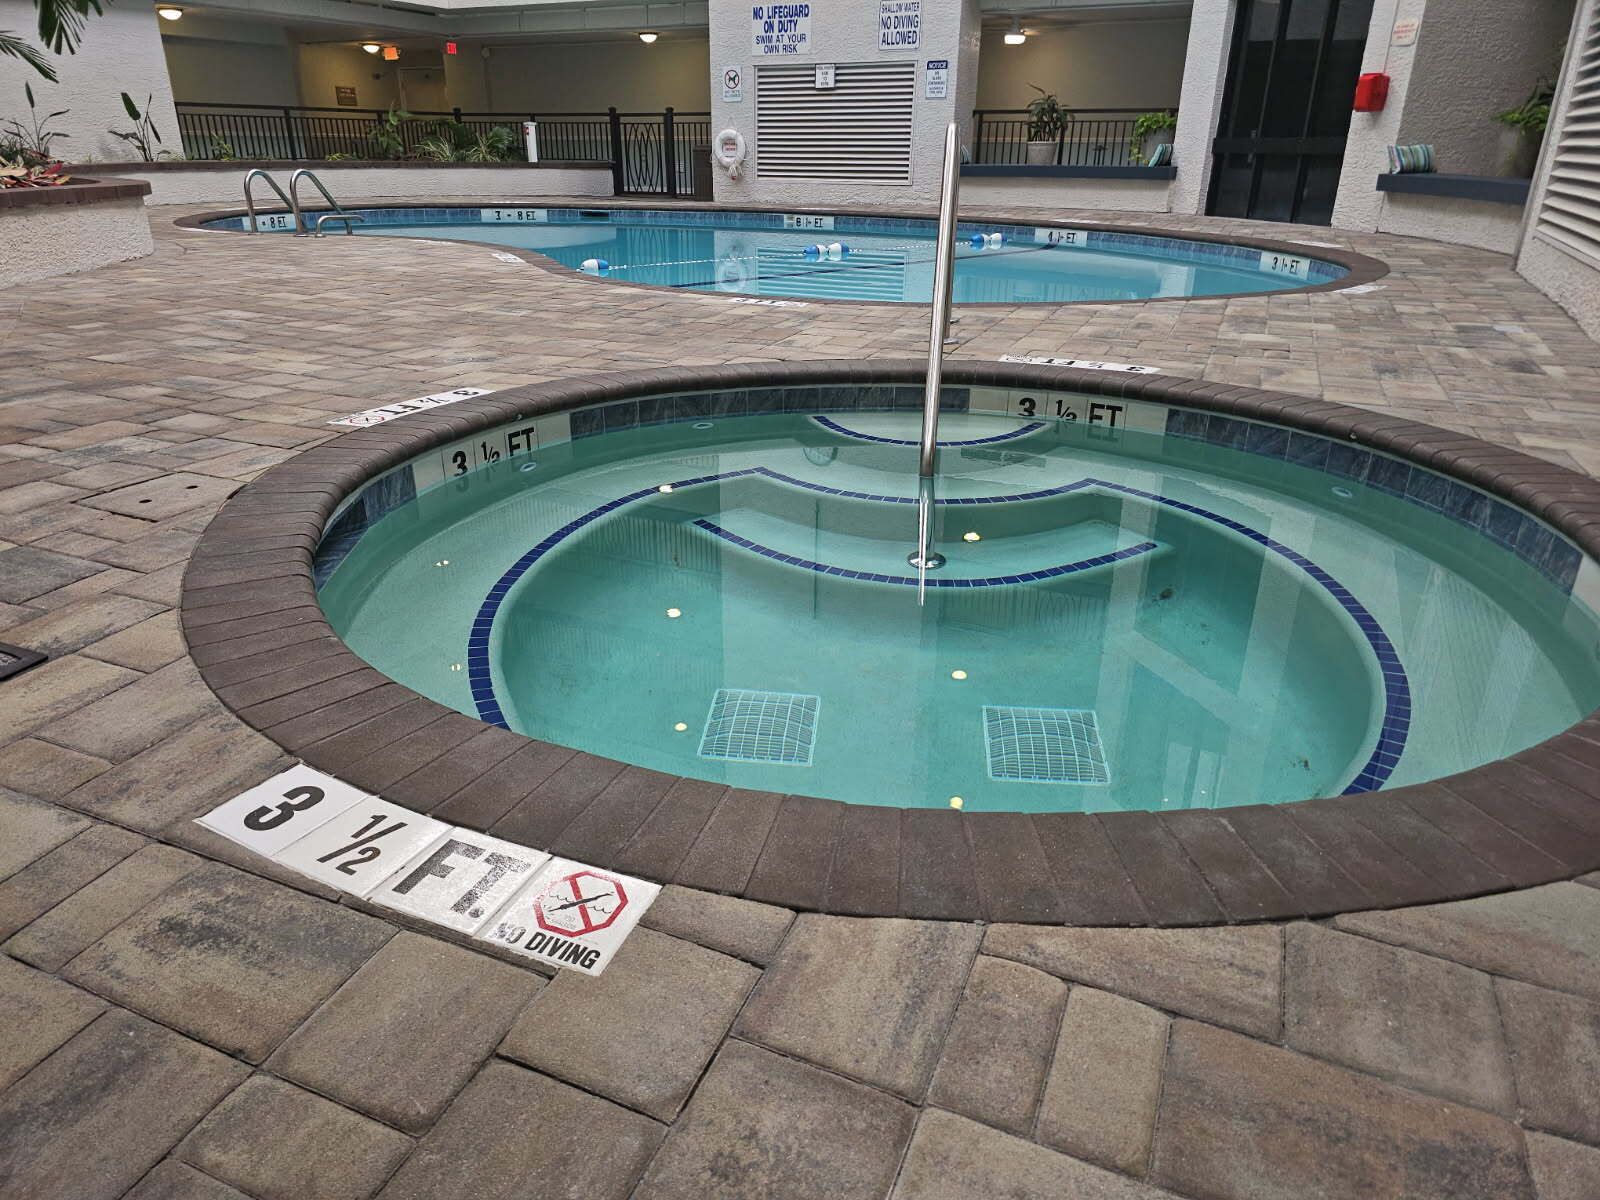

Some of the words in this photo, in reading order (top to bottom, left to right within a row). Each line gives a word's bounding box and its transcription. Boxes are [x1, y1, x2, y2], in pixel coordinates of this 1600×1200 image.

[753, 6, 763, 20] NO
[767, 4, 810, 19] LIFEGUARD
[903, 2, 919, 12] WATER
[764, 20, 774, 33] ON
[778, 19, 798, 33] DUTY
[881, 16, 891, 29] NO
[893, 15, 919, 29] DIVING
[756, 35, 773, 44] SWIM
[776, 34, 784, 43] AT
[787, 33, 806, 43] YOUR
[881, 31, 917, 45] ALLOWED
[764, 45, 779, 54] OWN
[783, 44, 798, 53] RISK
[1018, 397, 1036, 417] 3
[1089, 402, 1123, 427] FT
[452, 451, 468, 477] 3
[508, 427, 535, 457] FT
[243, 785, 325, 831] 3
[524, 931, 601, 970] DIVING
